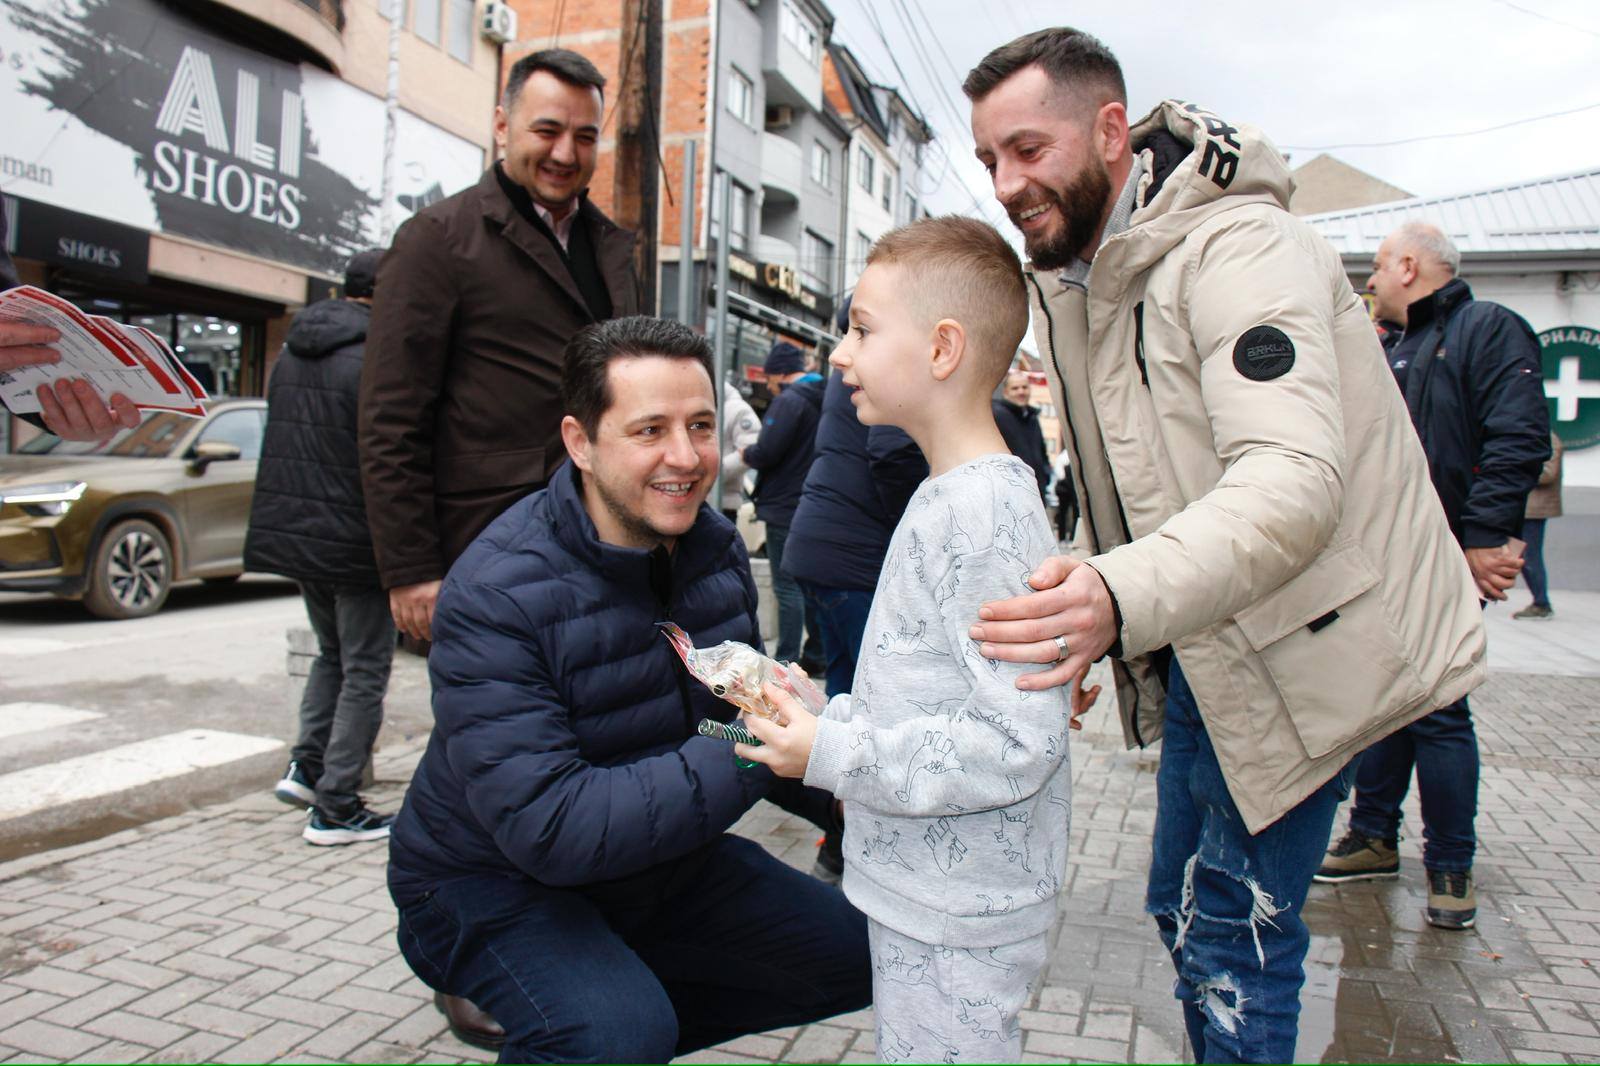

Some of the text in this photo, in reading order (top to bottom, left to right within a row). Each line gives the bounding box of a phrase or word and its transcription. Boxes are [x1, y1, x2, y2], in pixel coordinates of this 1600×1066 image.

[155, 46, 302, 178] ALI
[0, 155, 53, 186] man
[153, 140, 302, 230] SHOES
[58, 237, 121, 268] SHOES
